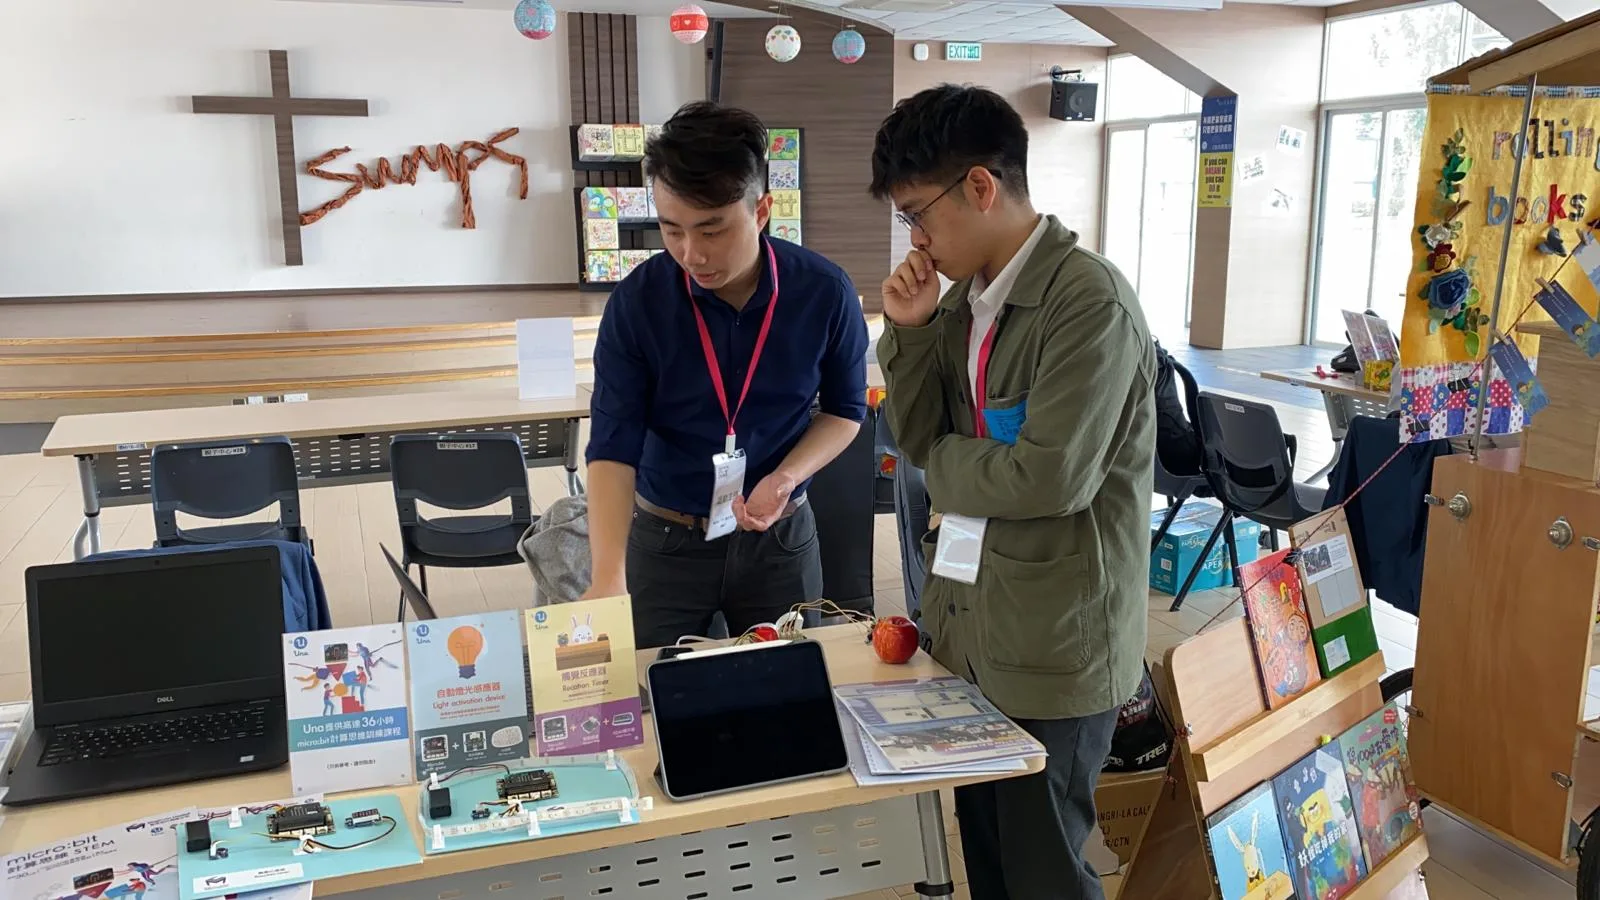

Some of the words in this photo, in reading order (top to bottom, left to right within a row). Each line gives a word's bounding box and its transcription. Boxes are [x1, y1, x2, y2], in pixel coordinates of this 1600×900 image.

[949, 45, 967, 58] EXIT
[968, 45, 980, 58] 出口
[1487, 183, 1587, 225] books
[1202, 559, 1223, 571] APER
[303, 723, 325, 734] Una
[7, 834, 98, 867] micro:bit
[73, 839, 116, 856] STEM
